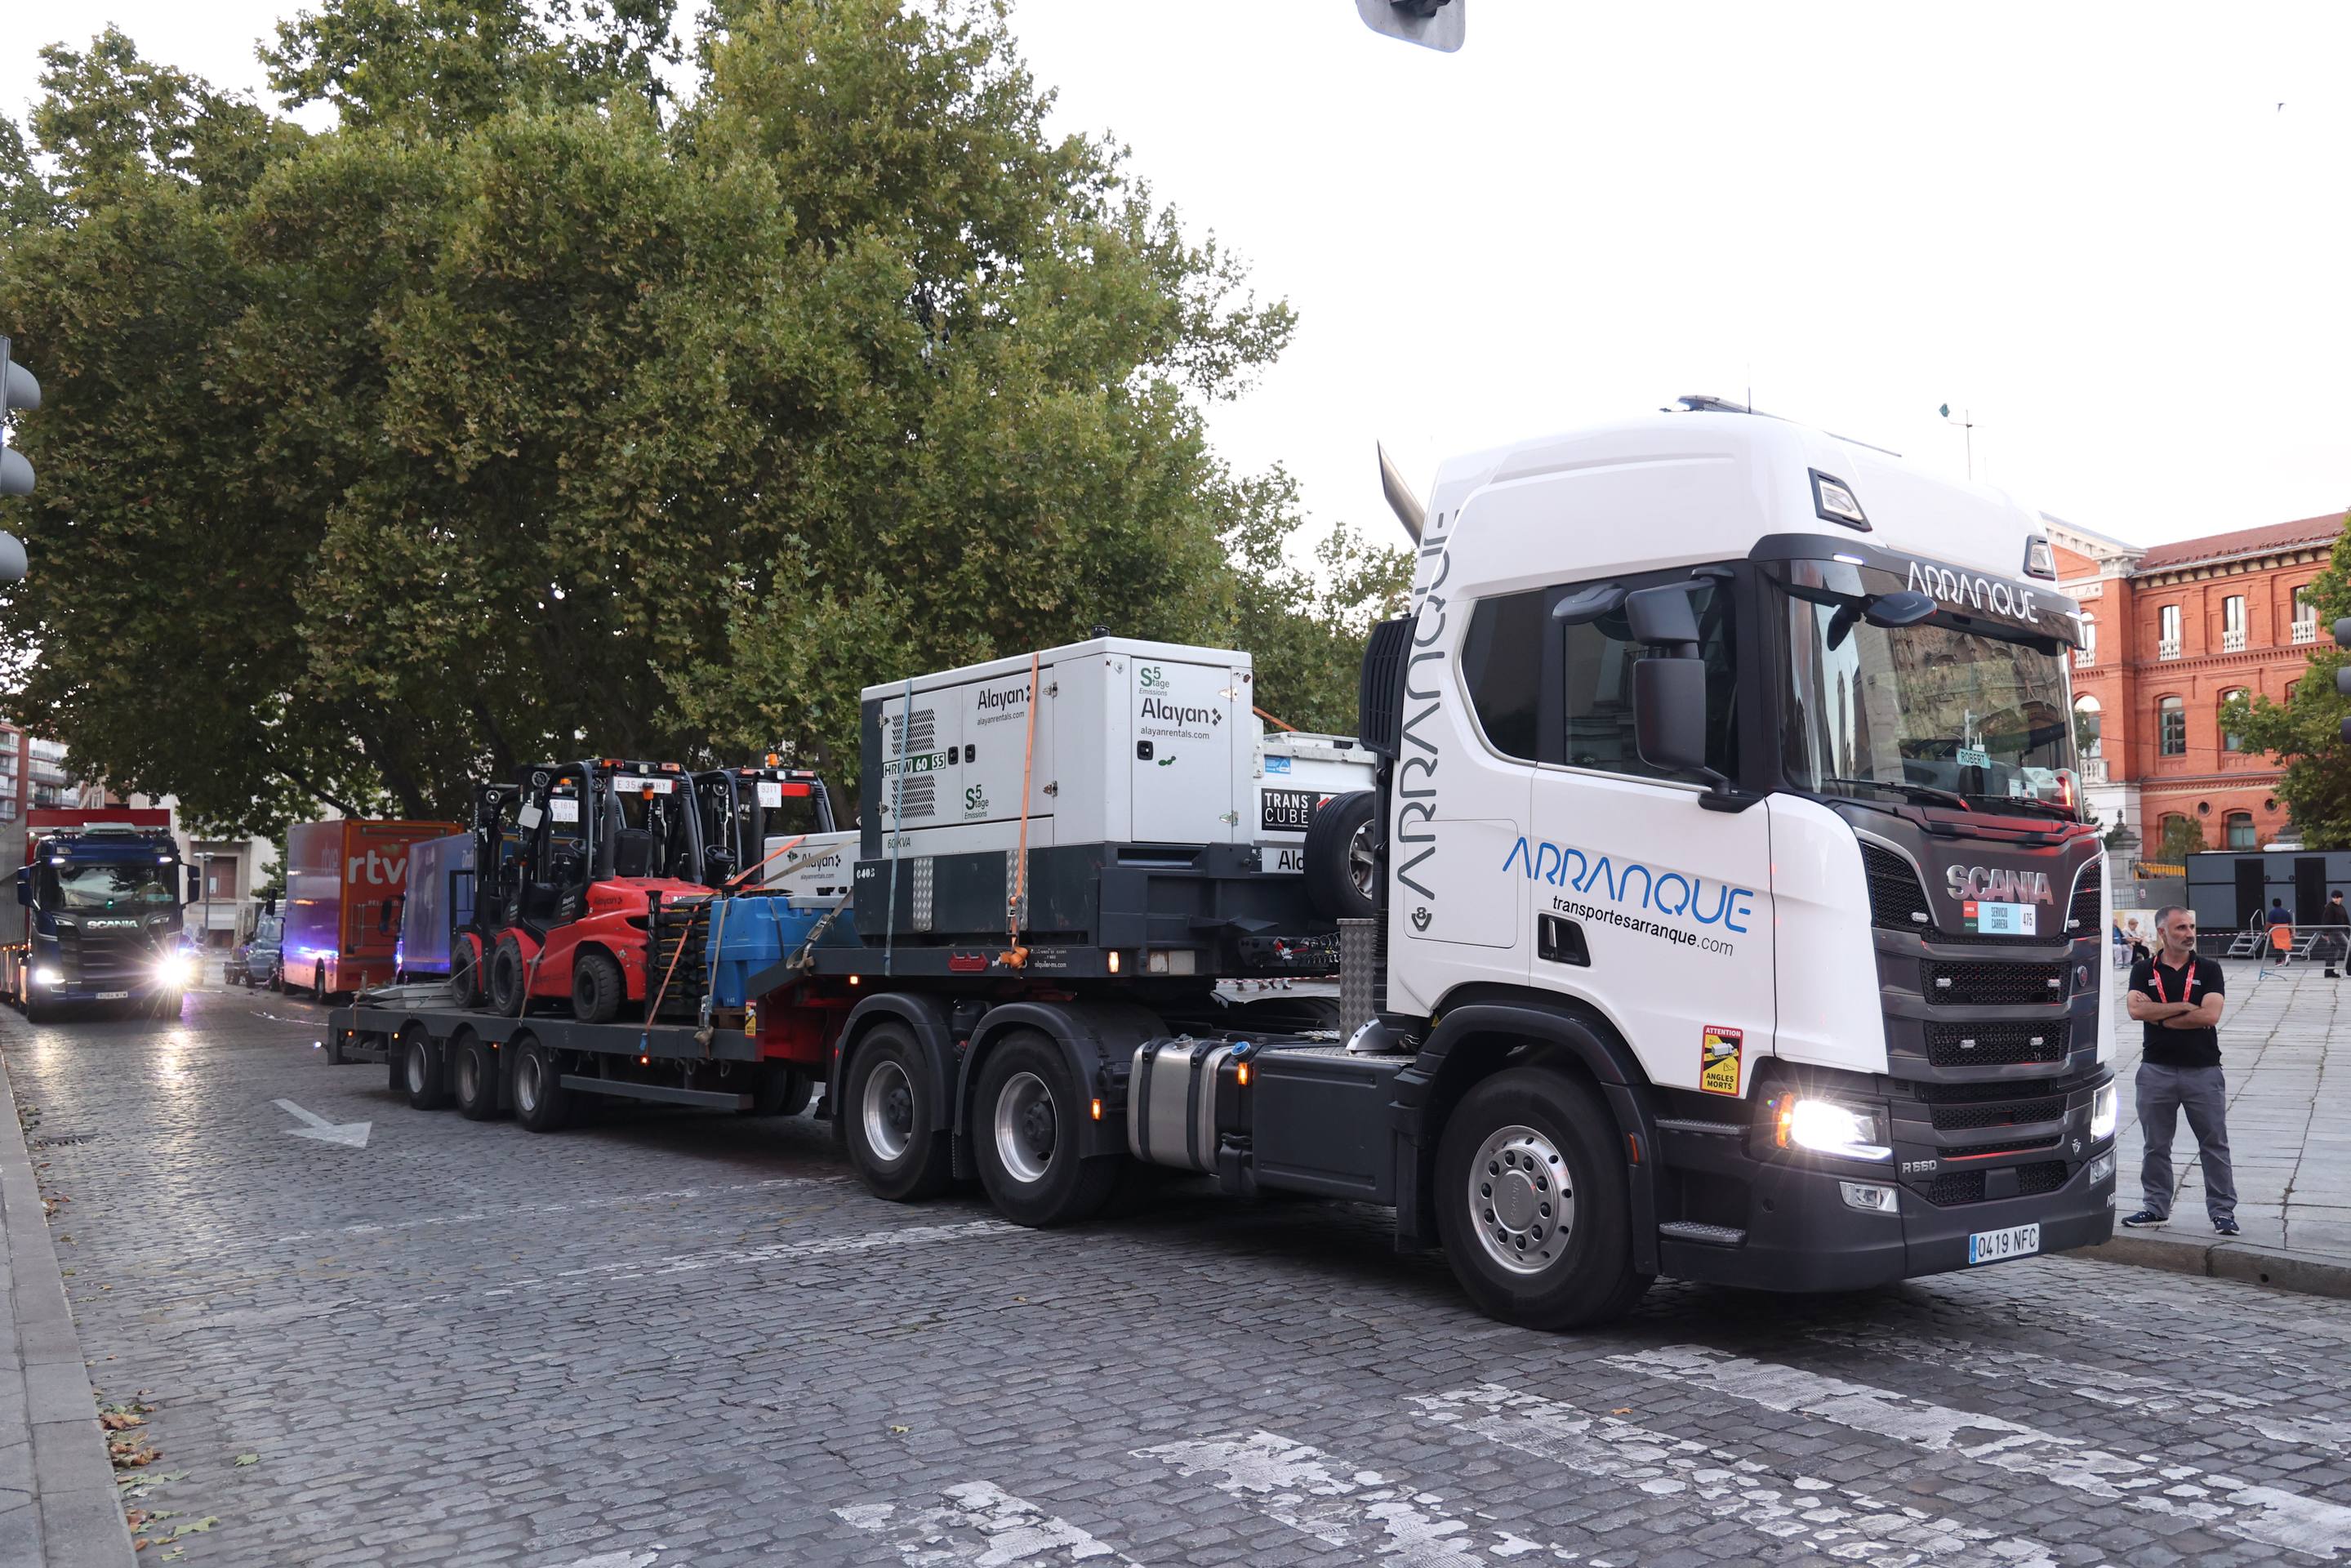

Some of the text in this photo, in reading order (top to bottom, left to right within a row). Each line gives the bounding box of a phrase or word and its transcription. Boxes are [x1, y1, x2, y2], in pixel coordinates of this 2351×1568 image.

[1908, 561, 2038, 623] ARRANQUE
[977, 688, 1024, 711] Alayan
[1138, 688, 1168, 697] Emissions
[977, 710, 1025, 726] alayanrentals.com
[1141, 697, 1209, 727] Alayan
[1140, 726, 1210, 740] alayanrentals.com
[885, 755, 944, 777] HRW 60 S5
[1961, 751, 1986, 766] ROBERT
[1264, 792, 1308, 809] TRANS
[964, 810, 987, 820] Emissions
[1265, 808, 1308, 824] CUBE
[348, 849, 408, 885] rtv
[1278, 850, 1304, 871] Ala
[1502, 836, 1754, 934] ARRANQUE
[1946, 864, 2055, 906] SCANIA
[1991, 906, 2008, 918] SERVICIO
[2023, 912, 2033, 927] 475
[87, 920, 139, 929] SCANIA
[1552, 894, 1734, 958] transportesarranque.com
[1991, 918, 2009, 929] CARRERA
[1705, 1027, 1741, 1037] ATTENTION
[1706, 1072, 1734, 1083] ANGLES
[1707, 1080, 1733, 1090] MORTS
[1978, 1235, 2009, 1258] 0419
[2013, 1227, 2037, 1251] NFC
